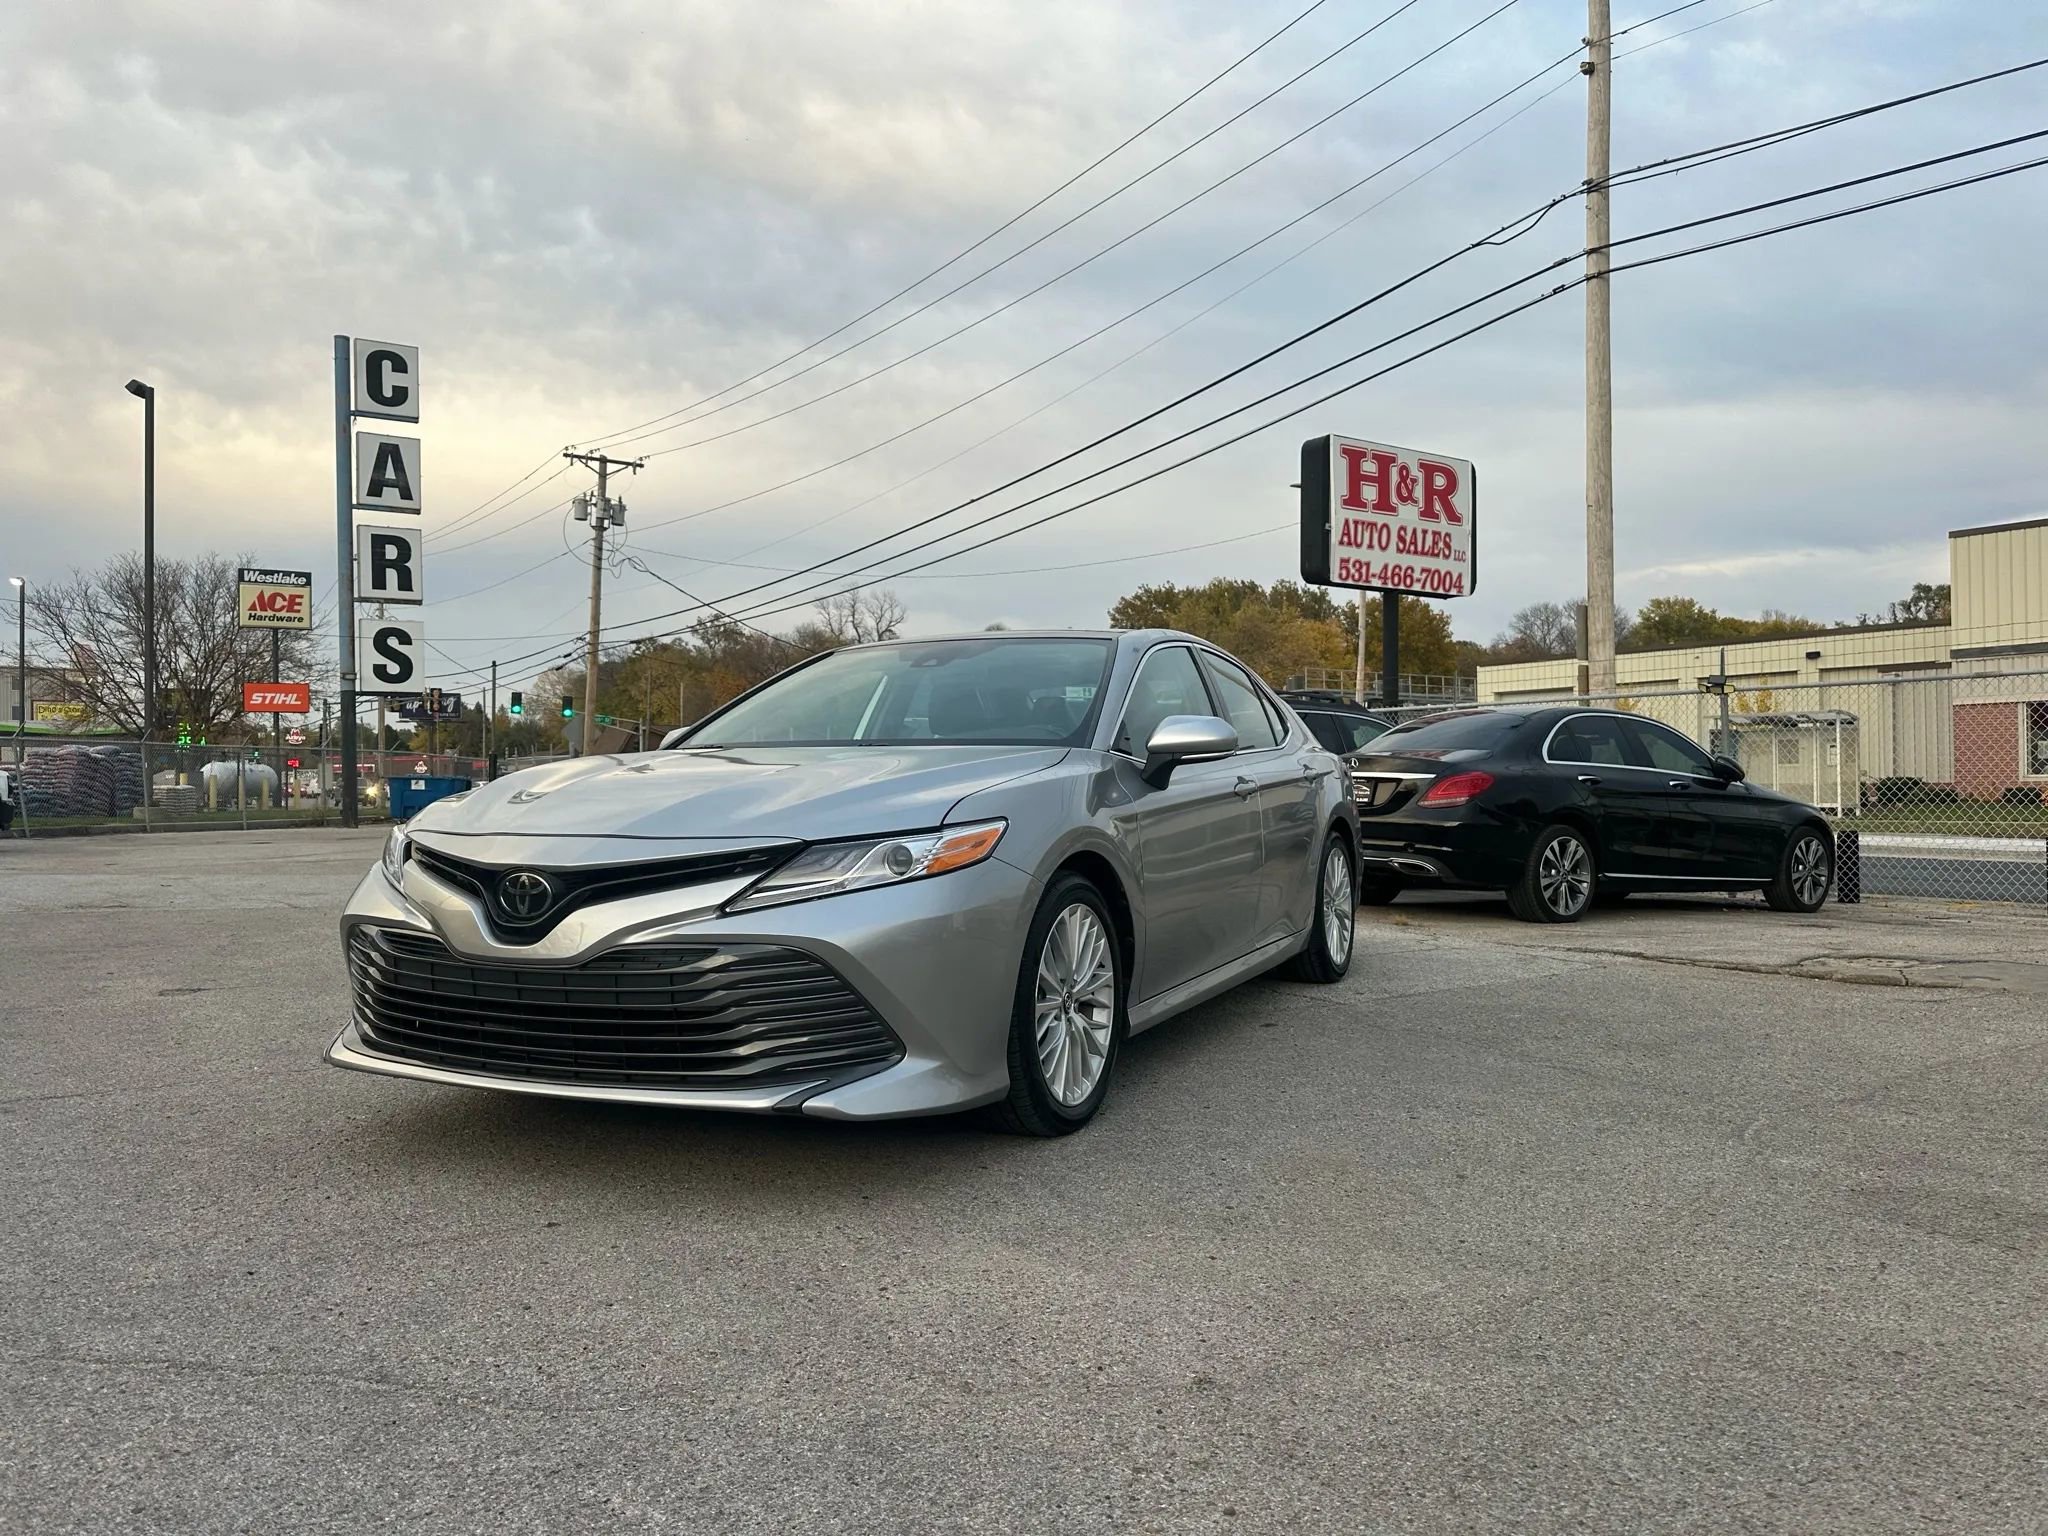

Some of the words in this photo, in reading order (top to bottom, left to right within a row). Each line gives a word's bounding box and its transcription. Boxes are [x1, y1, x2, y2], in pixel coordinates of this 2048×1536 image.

[1340, 444, 1463, 527] H&R
[365, 349, 415, 685] CARS
[1338, 517, 1391, 552] AUTO
[1396, 524, 1452, 560] SALES
[1453, 549, 1466, 562] LLC
[243, 570, 307, 585] Westlake
[1338, 556, 1464, 594] 531-466-7004
[247, 588, 304, 613] ACE
[247, 612, 304, 623] Hardware
[249, 692, 302, 705] STIHL
